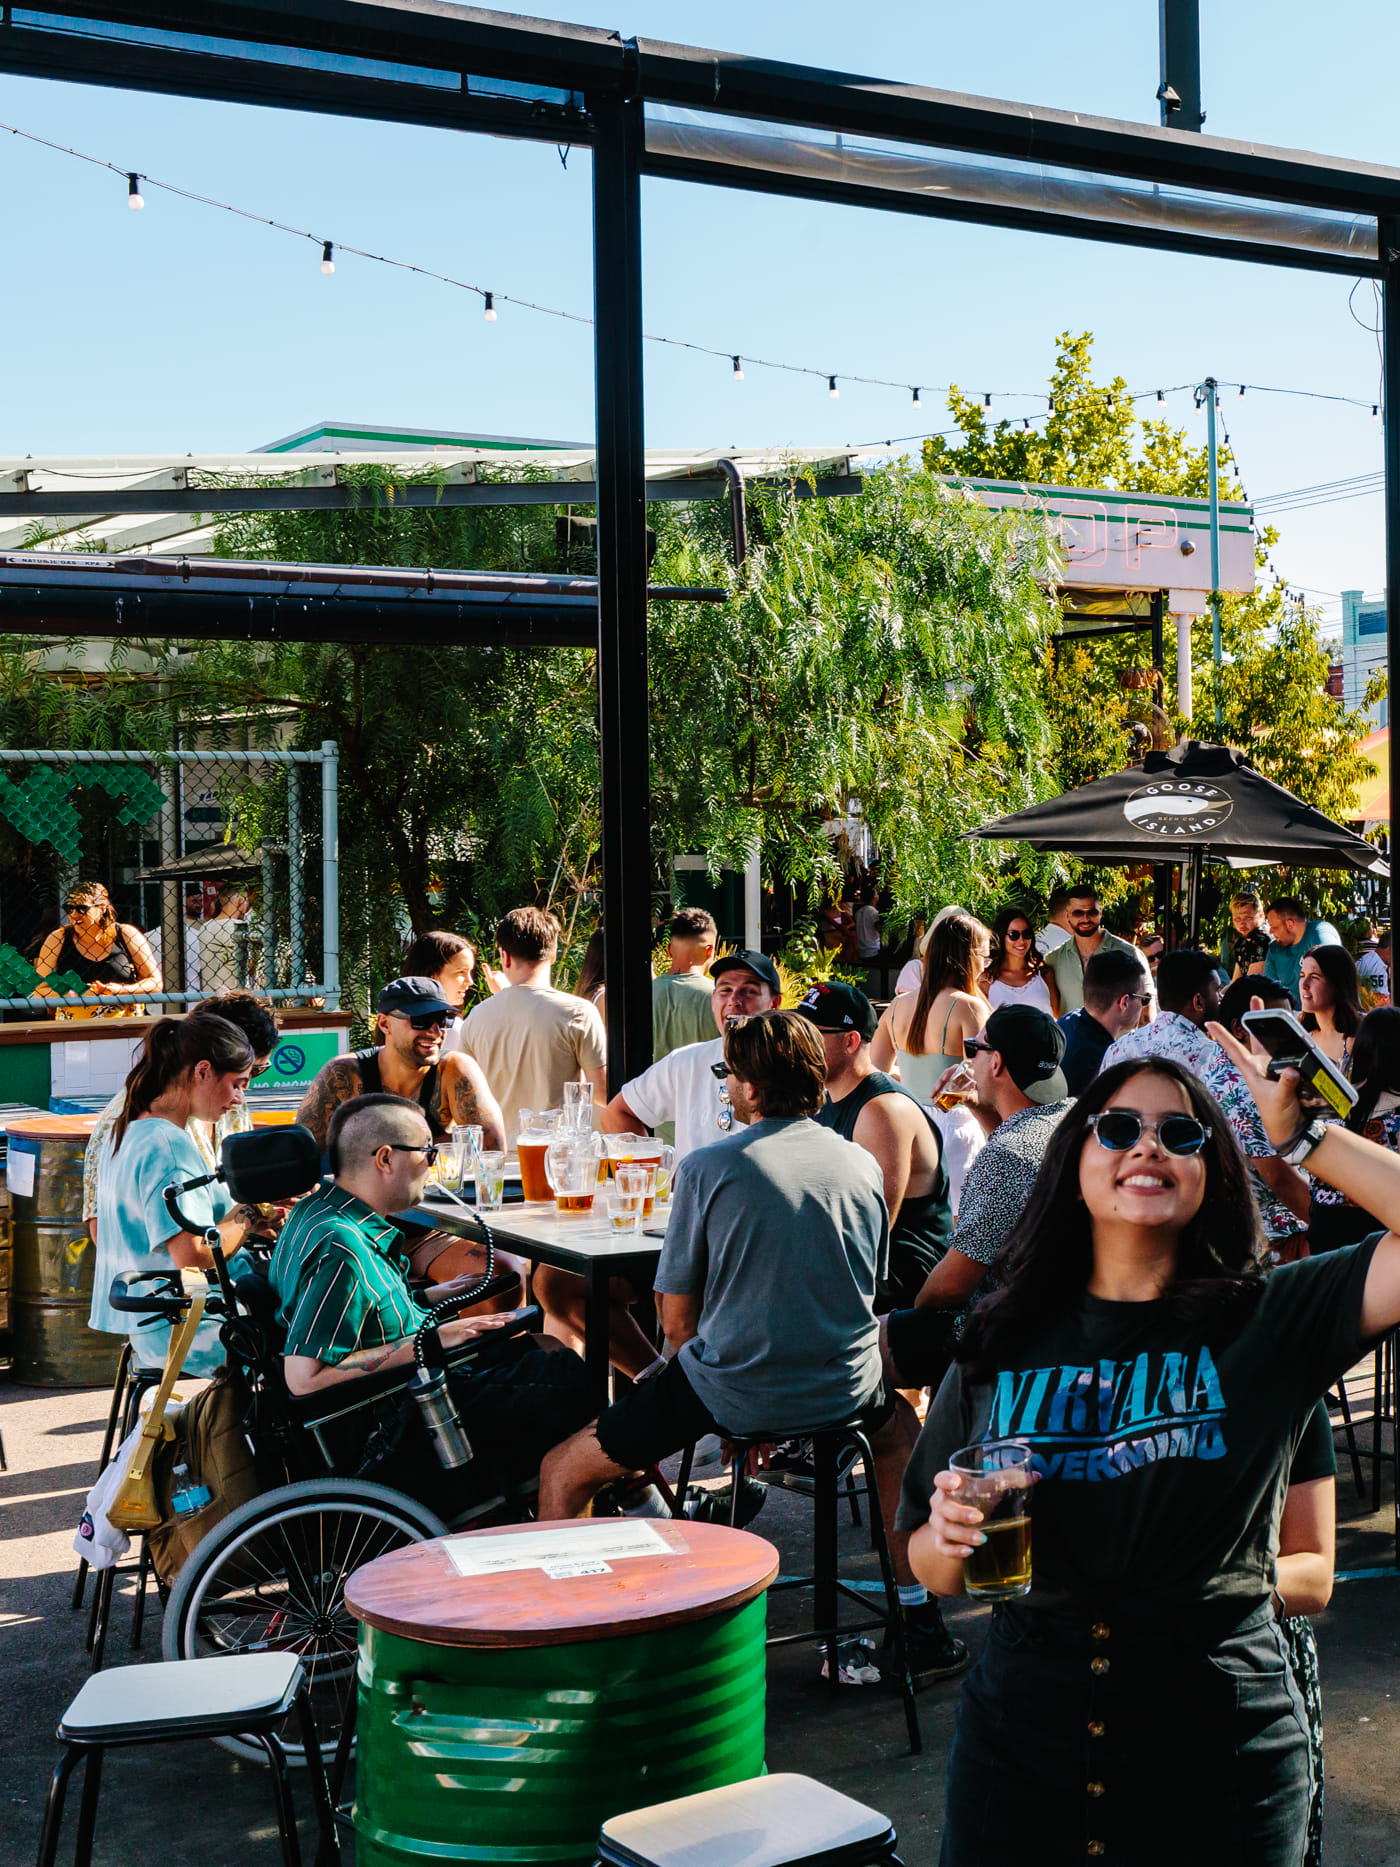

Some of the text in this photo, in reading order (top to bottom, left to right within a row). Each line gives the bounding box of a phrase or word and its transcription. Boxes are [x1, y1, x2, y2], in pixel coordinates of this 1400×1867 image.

[1146, 783, 1219, 797] GOOSE
[1137, 818, 1216, 834] ISLAND
[982, 1345, 1227, 1441] NIRVANA
